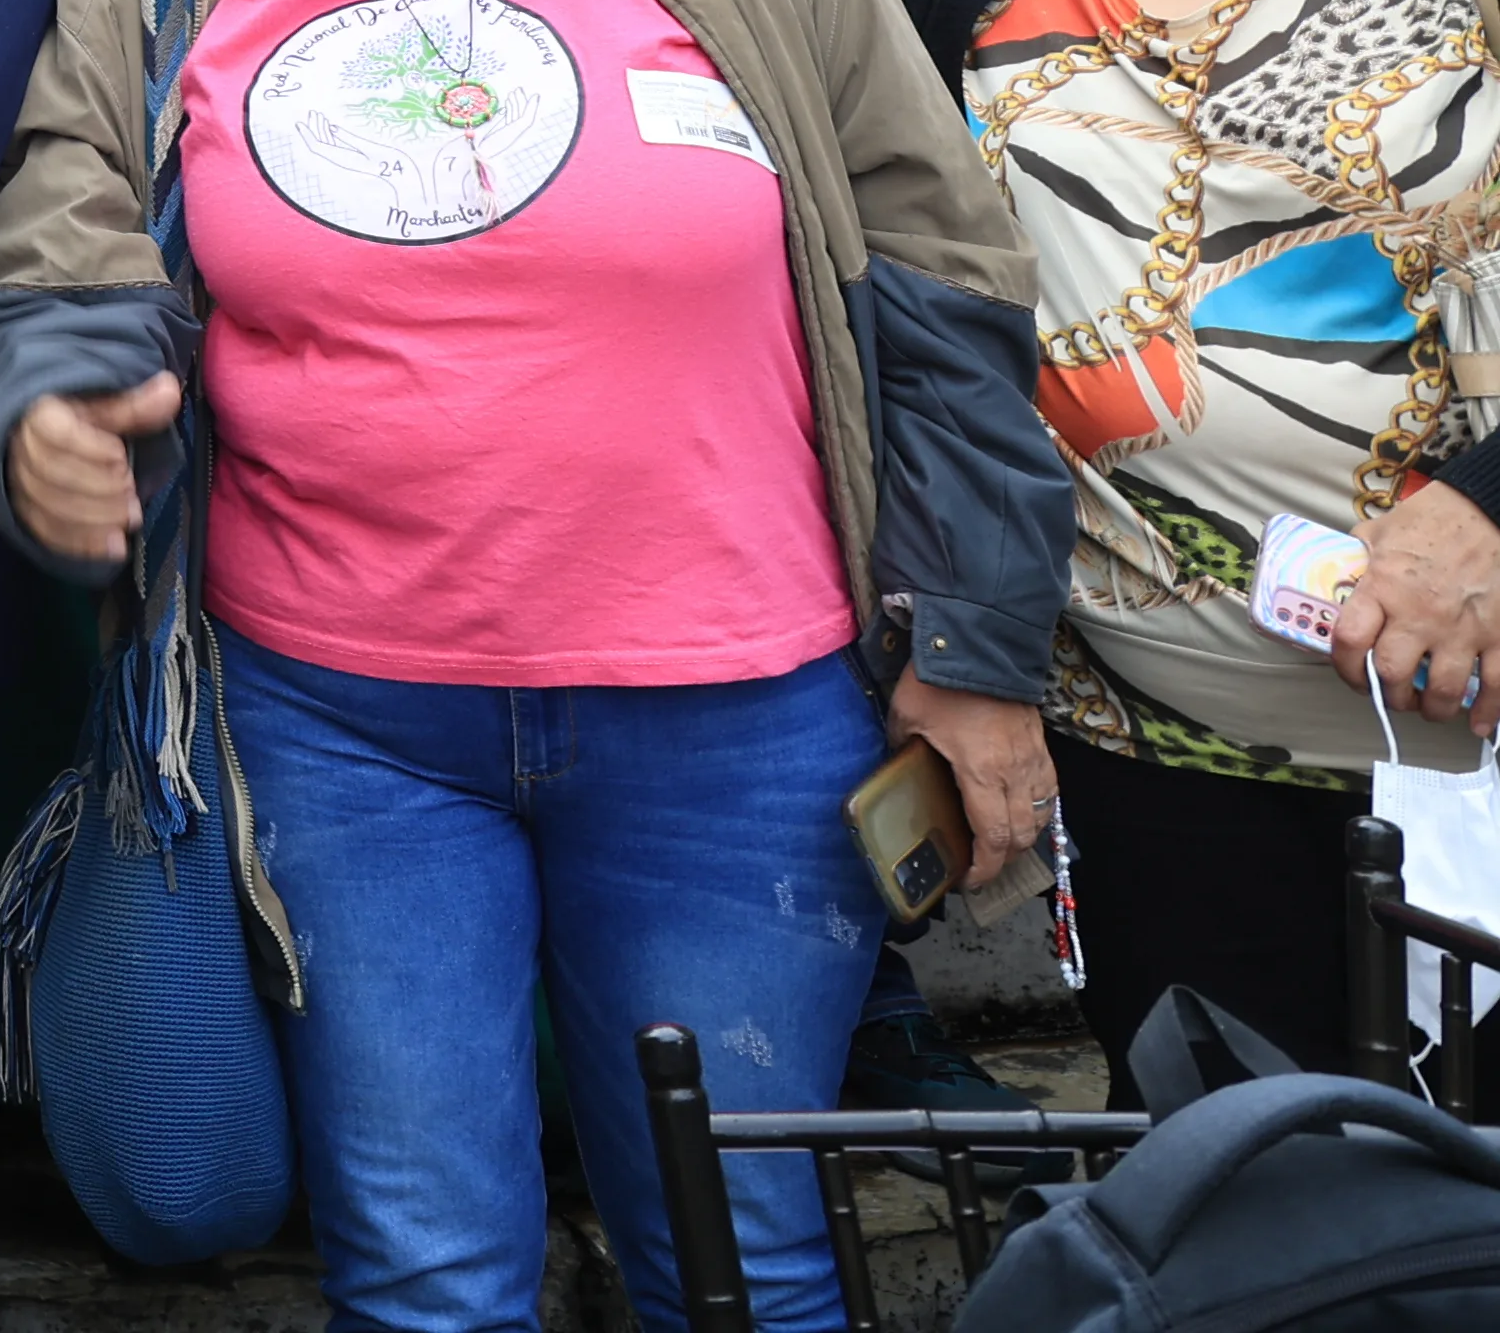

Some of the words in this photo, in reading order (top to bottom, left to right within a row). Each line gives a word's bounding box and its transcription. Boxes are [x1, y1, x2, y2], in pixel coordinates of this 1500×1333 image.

[352, 7, 389, 26] De
[281, 17, 352, 68] Nacional
[489, 3, 557, 66] Familiares
[263, 67, 302, 101] Red
[379, 160, 404, 177] 24
